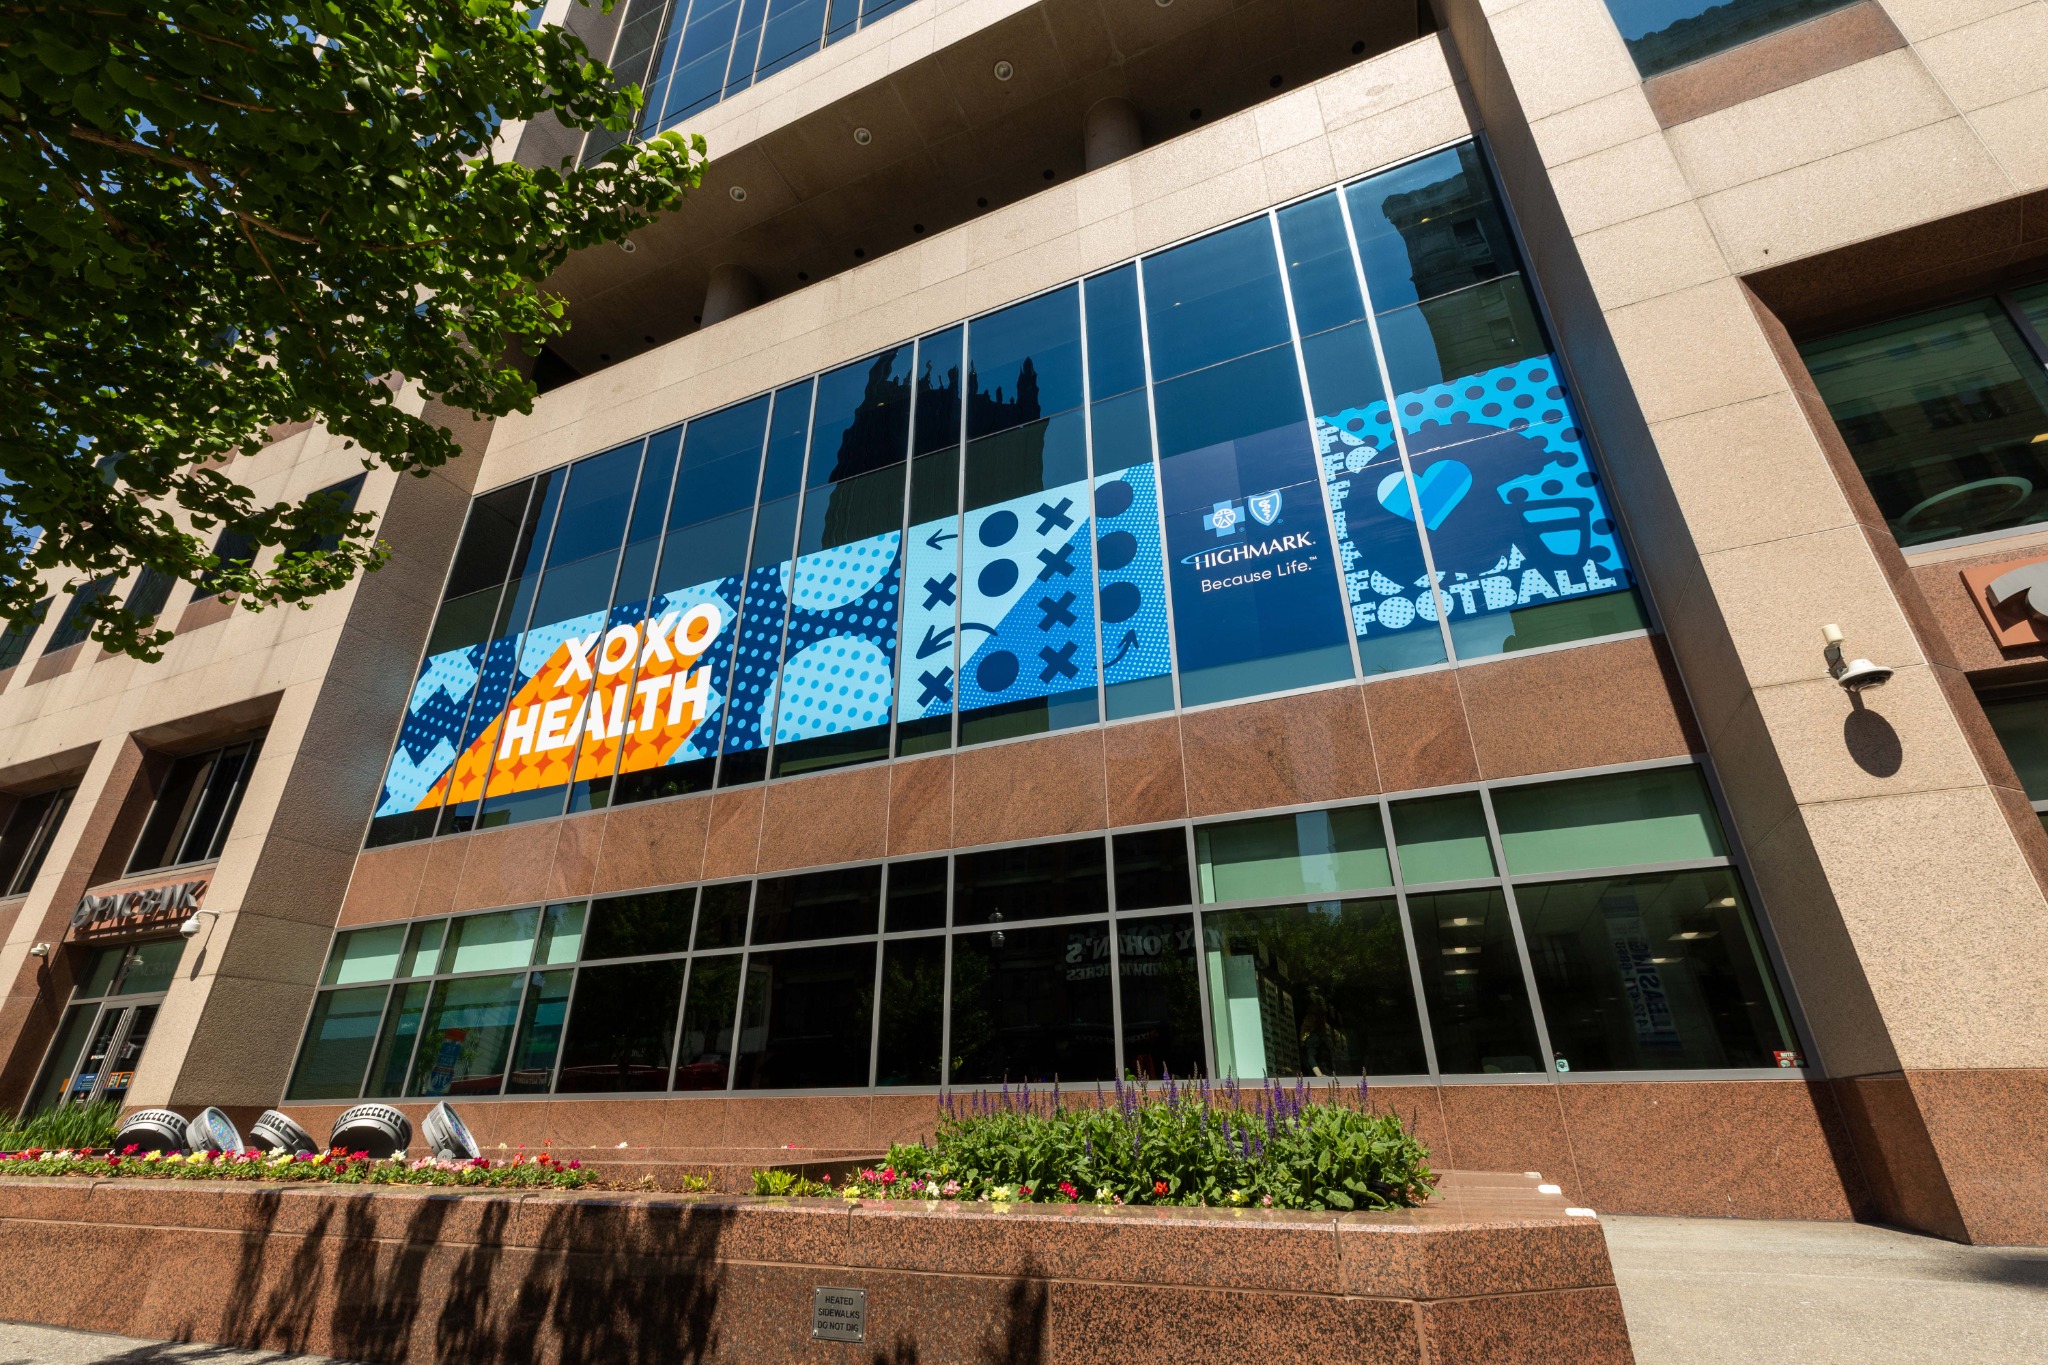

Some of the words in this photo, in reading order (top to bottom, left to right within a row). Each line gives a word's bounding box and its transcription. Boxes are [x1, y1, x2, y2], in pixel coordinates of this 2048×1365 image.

[1194, 531, 1313, 571] HIGHMARK
[1201, 570, 1272, 593] Because
[1351, 558, 1618, 637] FOOTBALL
[553, 602, 722, 688] XOXO
[498, 665, 713, 761] HEALTH
[818, 1308, 860, 1319] SIDEWALKS
[825, 1296, 854, 1306] HEATED
[818, 1321, 828, 1329] DO
[830, 1322, 845, 1331] NOT
[846, 1323, 859, 1332] DIG
